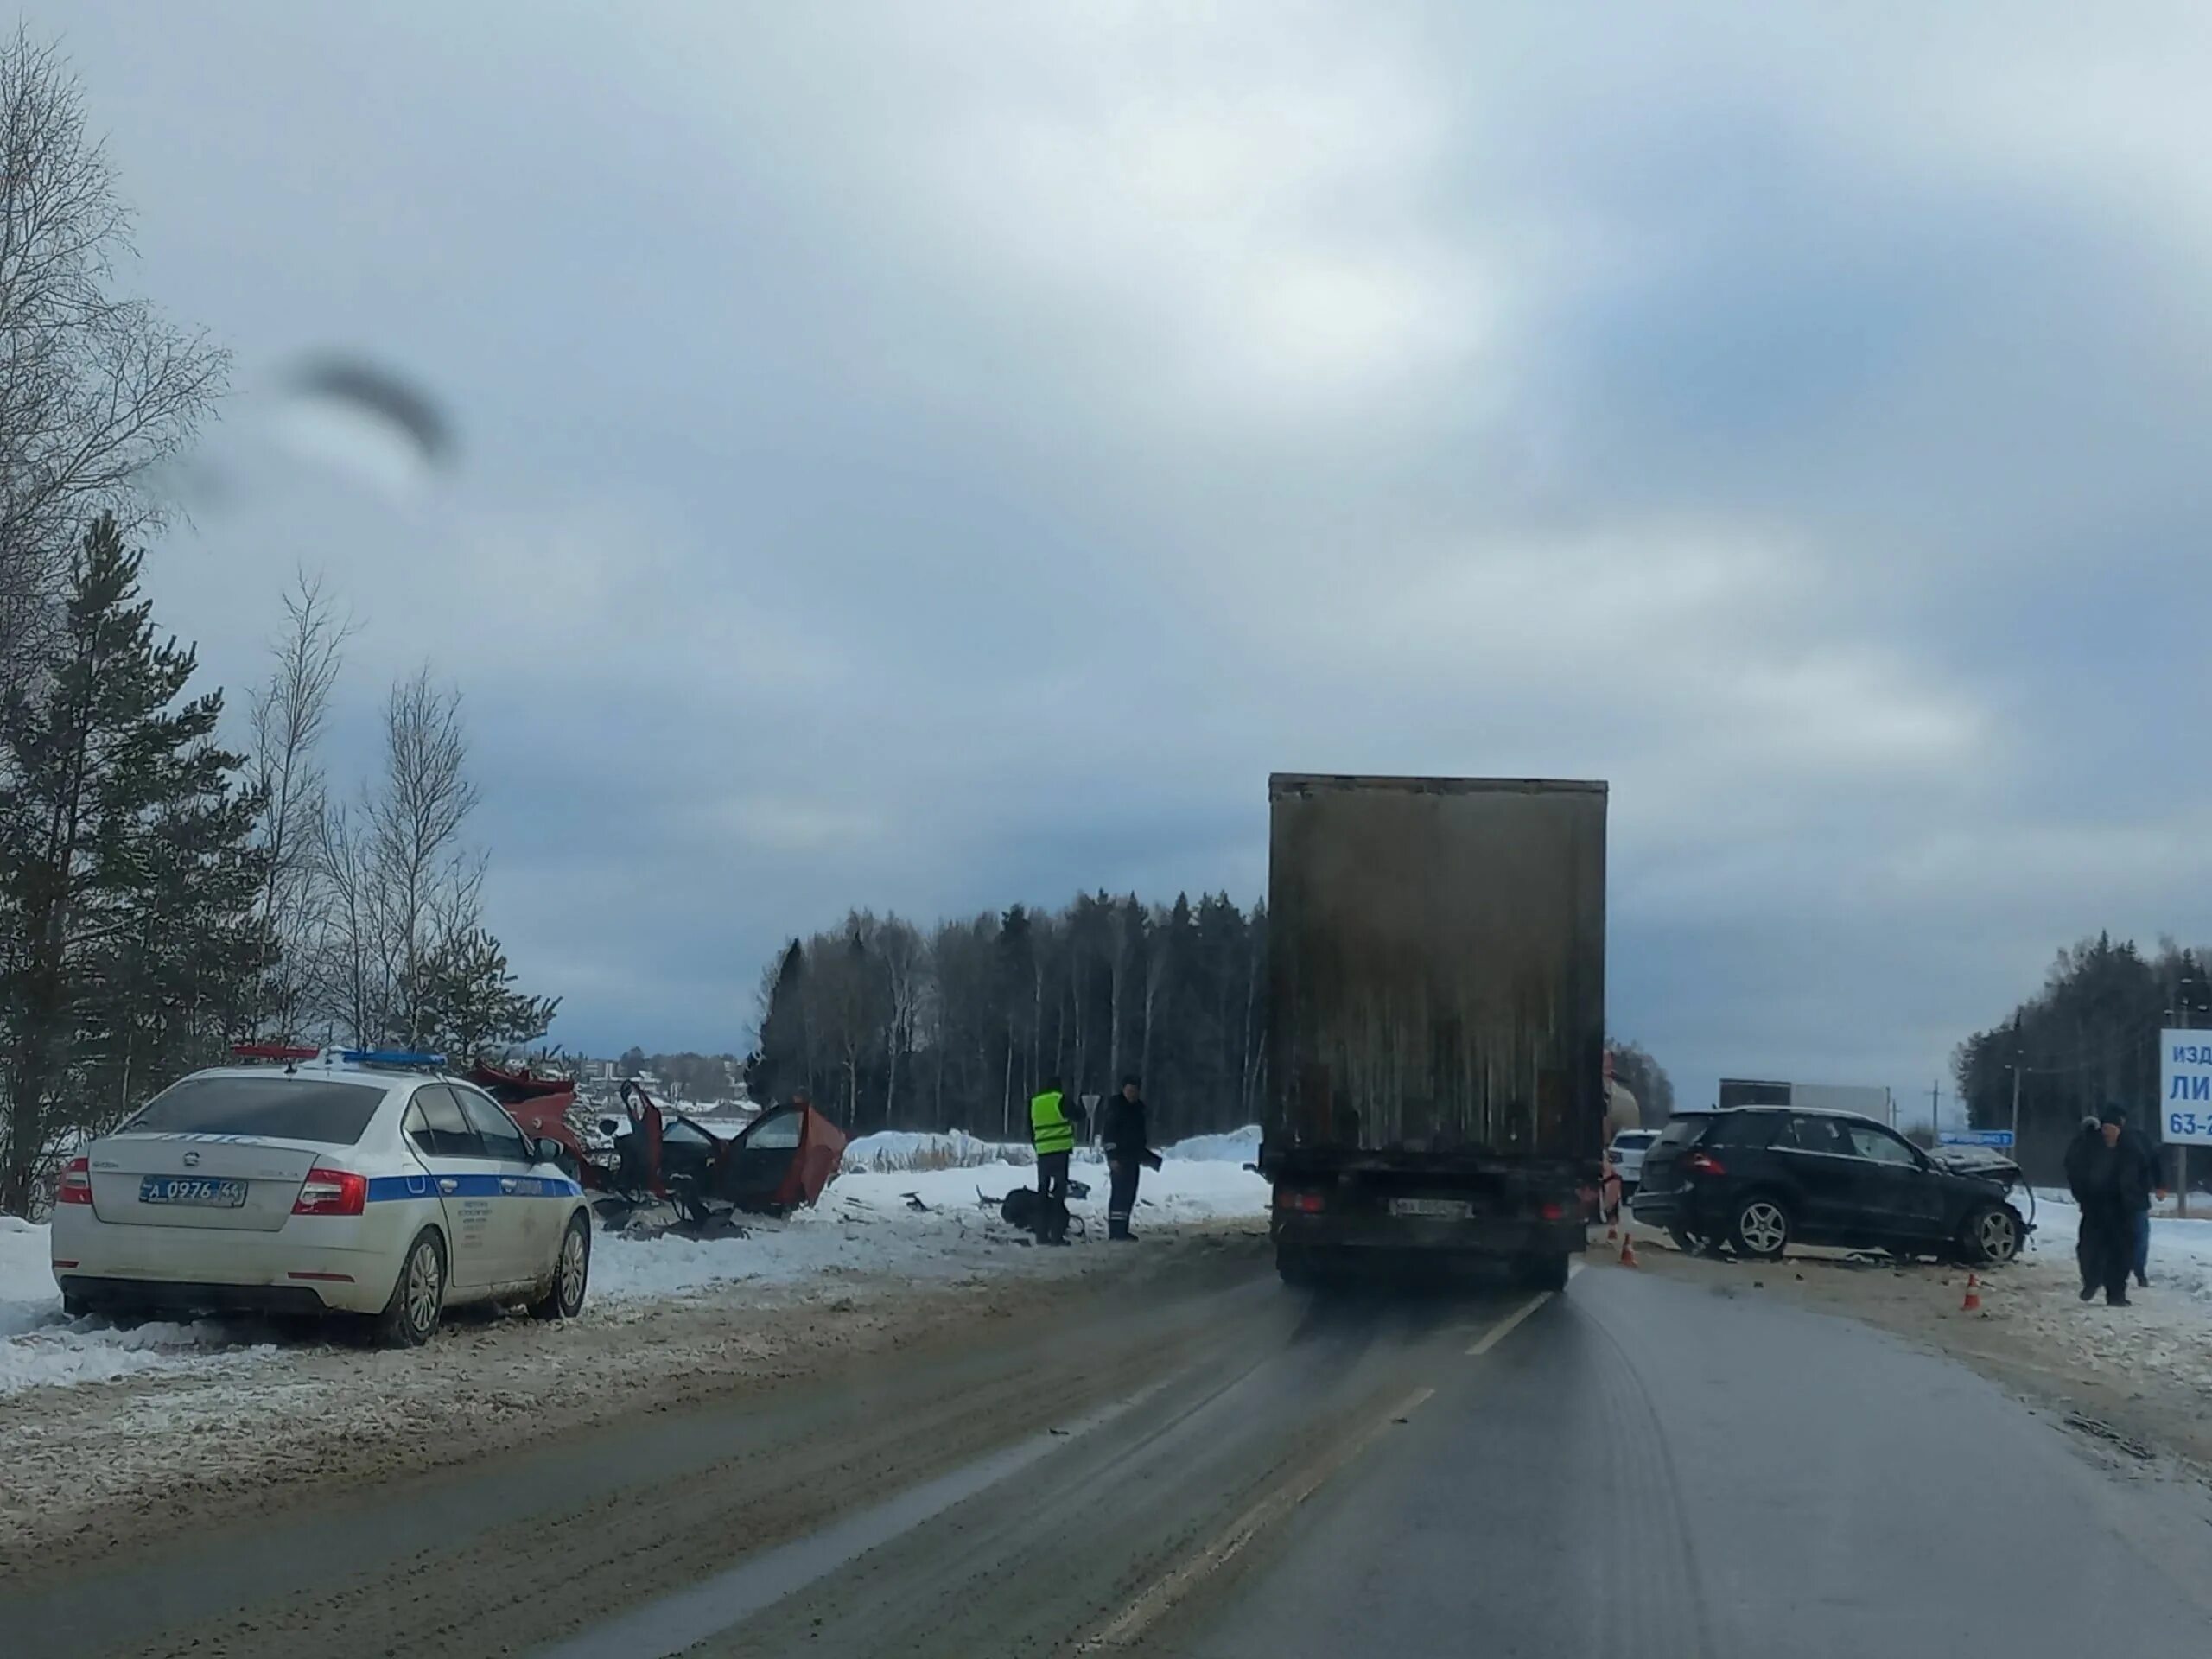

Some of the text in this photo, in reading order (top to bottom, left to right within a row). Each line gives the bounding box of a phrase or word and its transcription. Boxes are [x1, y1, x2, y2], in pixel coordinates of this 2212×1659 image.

[2172, 1046, 2212, 1065] ИЗД
[2170, 1075, 2209, 1101] ЛИ
[167, 1181, 213, 1199] 0976
